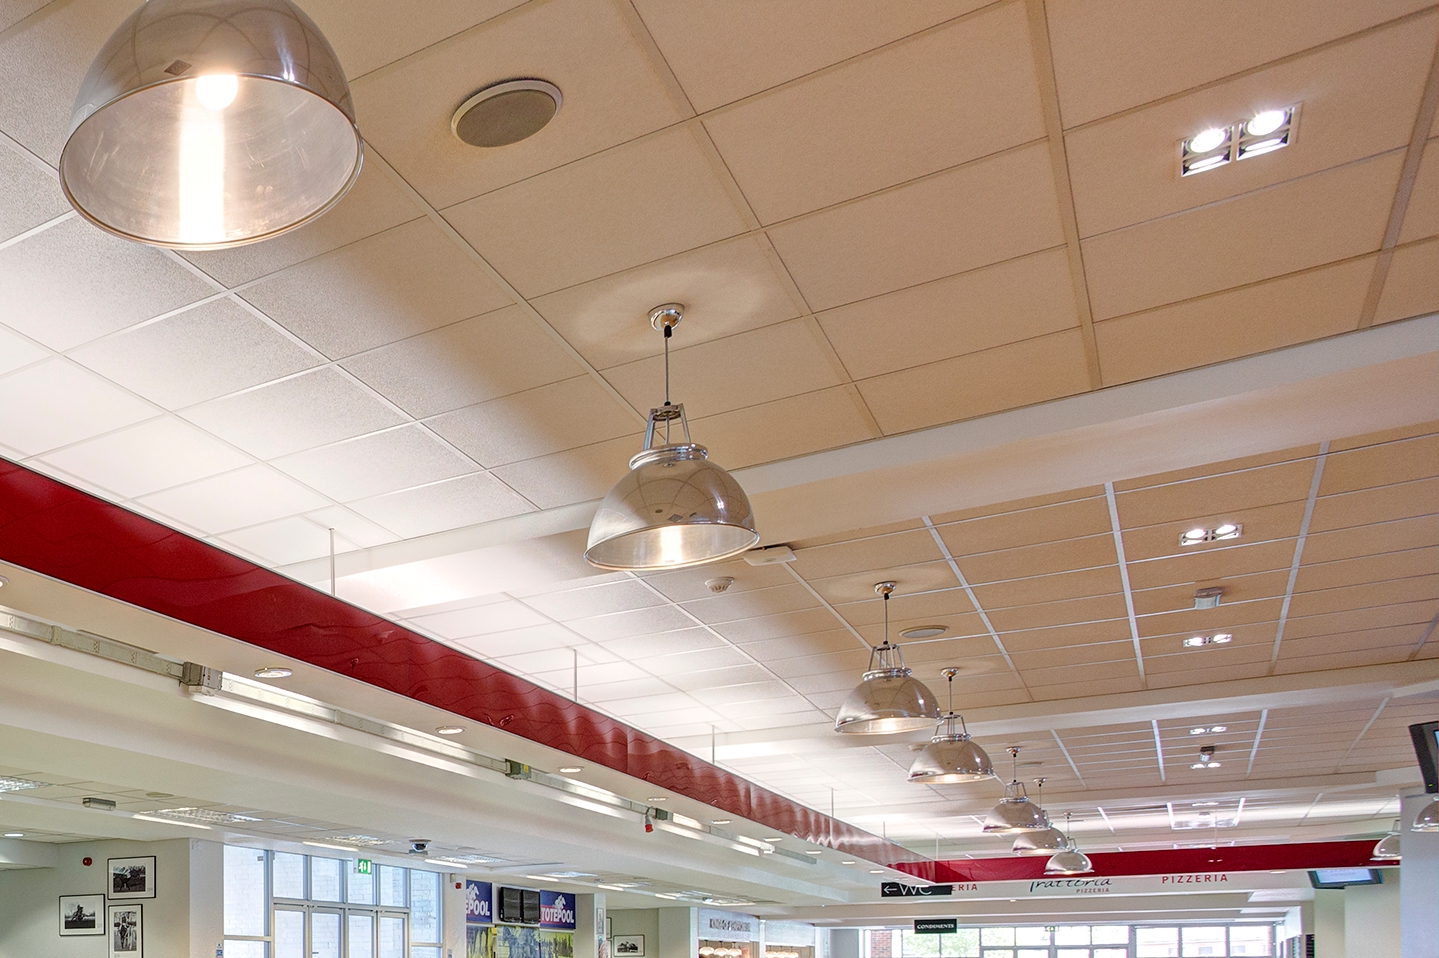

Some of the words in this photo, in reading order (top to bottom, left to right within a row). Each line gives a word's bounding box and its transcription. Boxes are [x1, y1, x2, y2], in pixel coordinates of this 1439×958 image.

[1029, 878, 1112, 893] Trattoria
[1161, 874, 1228, 884] PIZZERIA
[541, 907, 574, 924] TOTEPOOL
